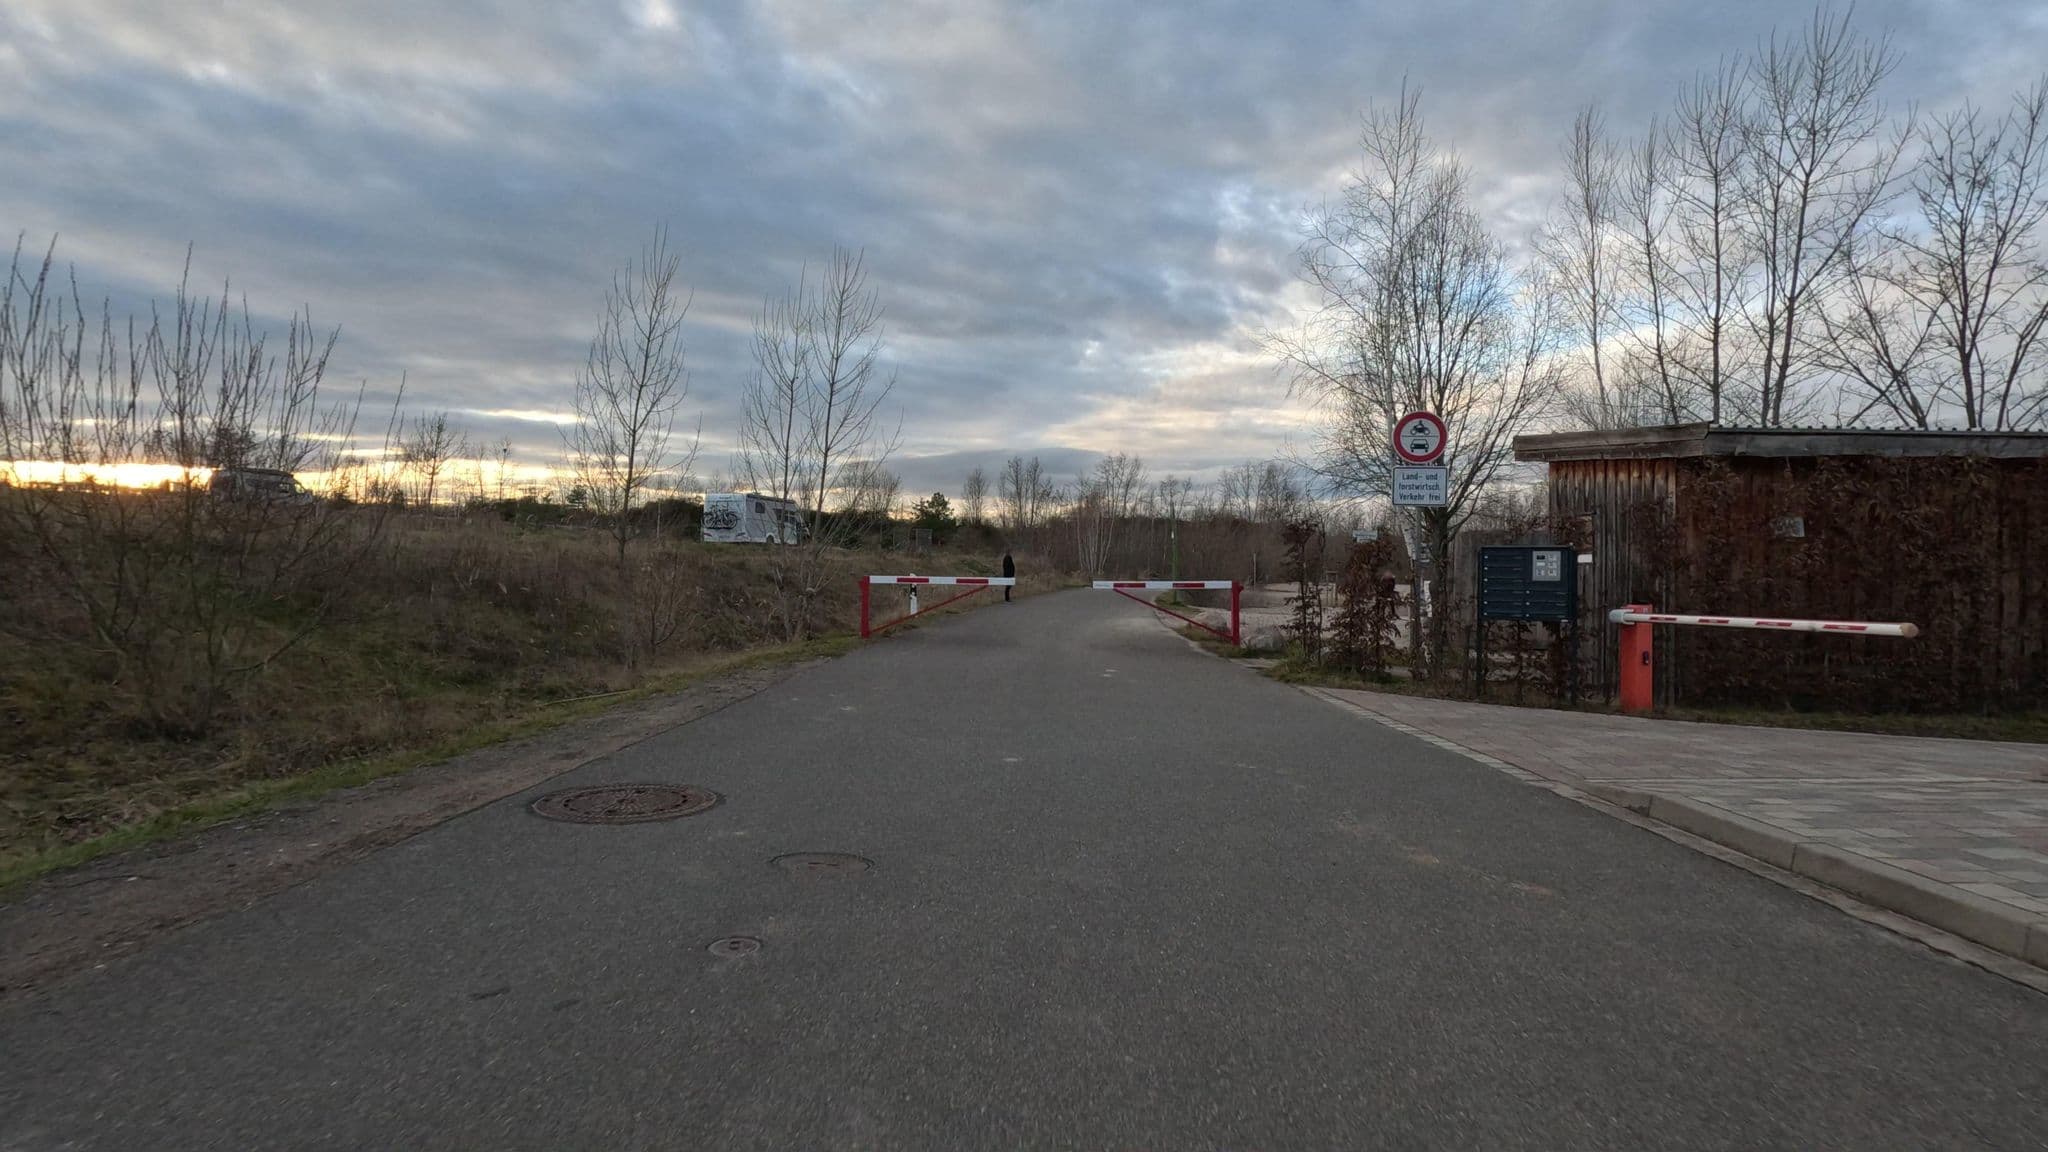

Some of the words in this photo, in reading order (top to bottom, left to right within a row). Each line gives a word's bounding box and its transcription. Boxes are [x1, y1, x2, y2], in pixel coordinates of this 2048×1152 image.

[1402, 472, 1423, 480] Land-
[1426, 472, 1438, 480] und
[1399, 492, 1425, 500] Verkehr
[1429, 492, 1441, 501] frei
